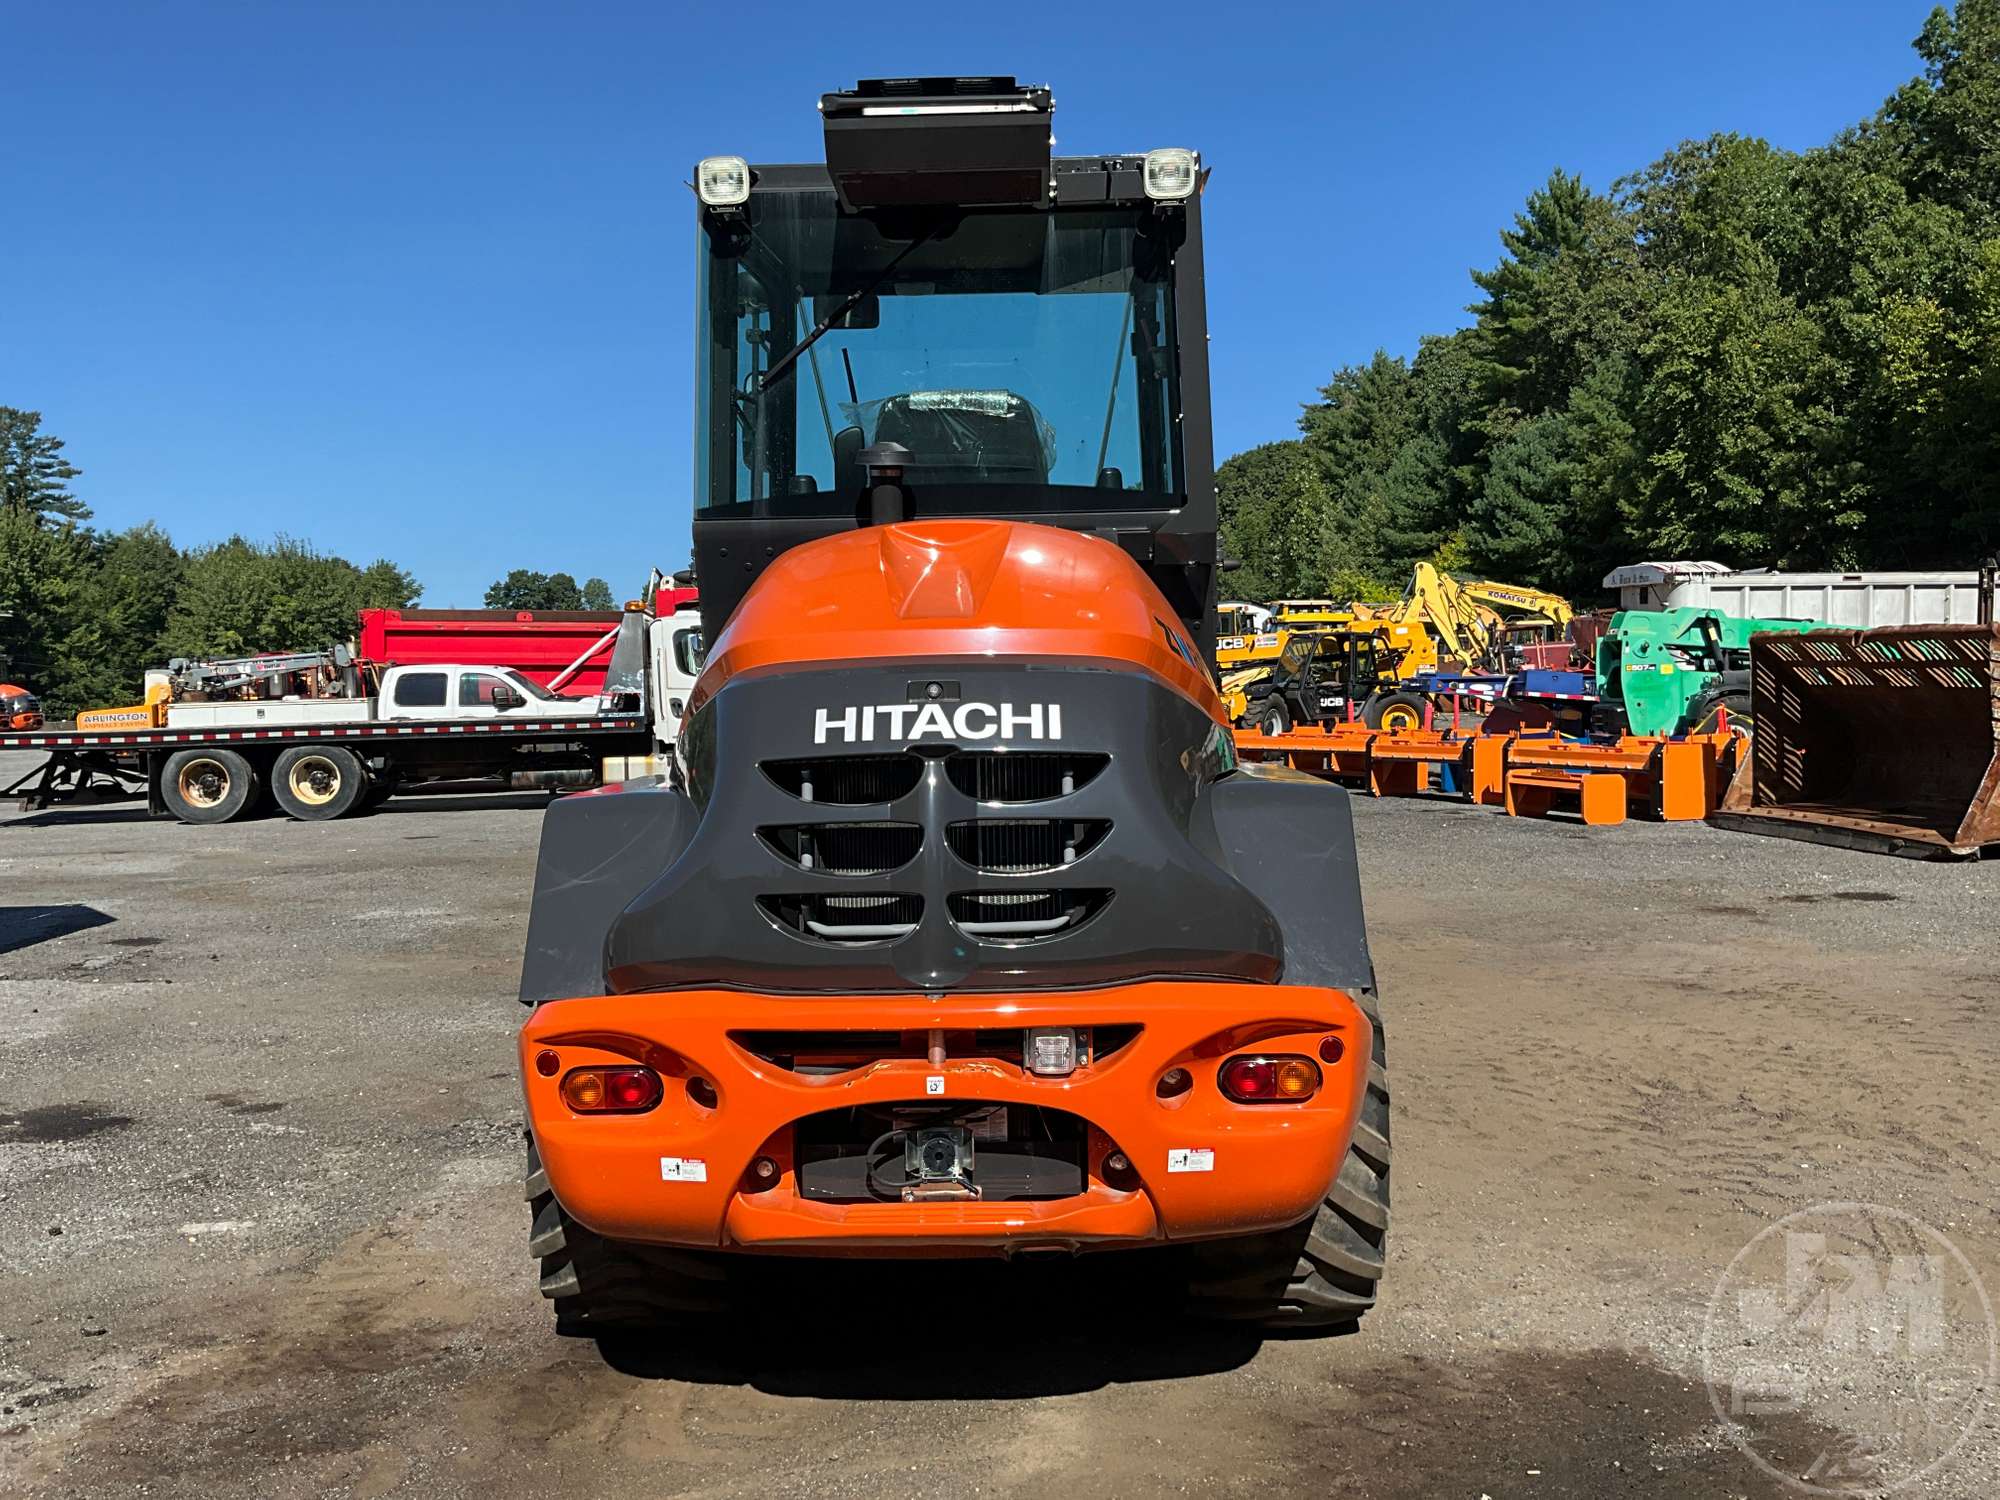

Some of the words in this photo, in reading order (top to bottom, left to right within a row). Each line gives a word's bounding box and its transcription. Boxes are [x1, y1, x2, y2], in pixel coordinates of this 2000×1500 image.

[1488, 590, 1526, 603] KOMATSU
[1216, 638, 1244, 650] JCB
[1320, 697, 1344, 707] JCB
[84, 713, 148, 723] ARLINGTON
[814, 702, 1062, 744] HITACHI
